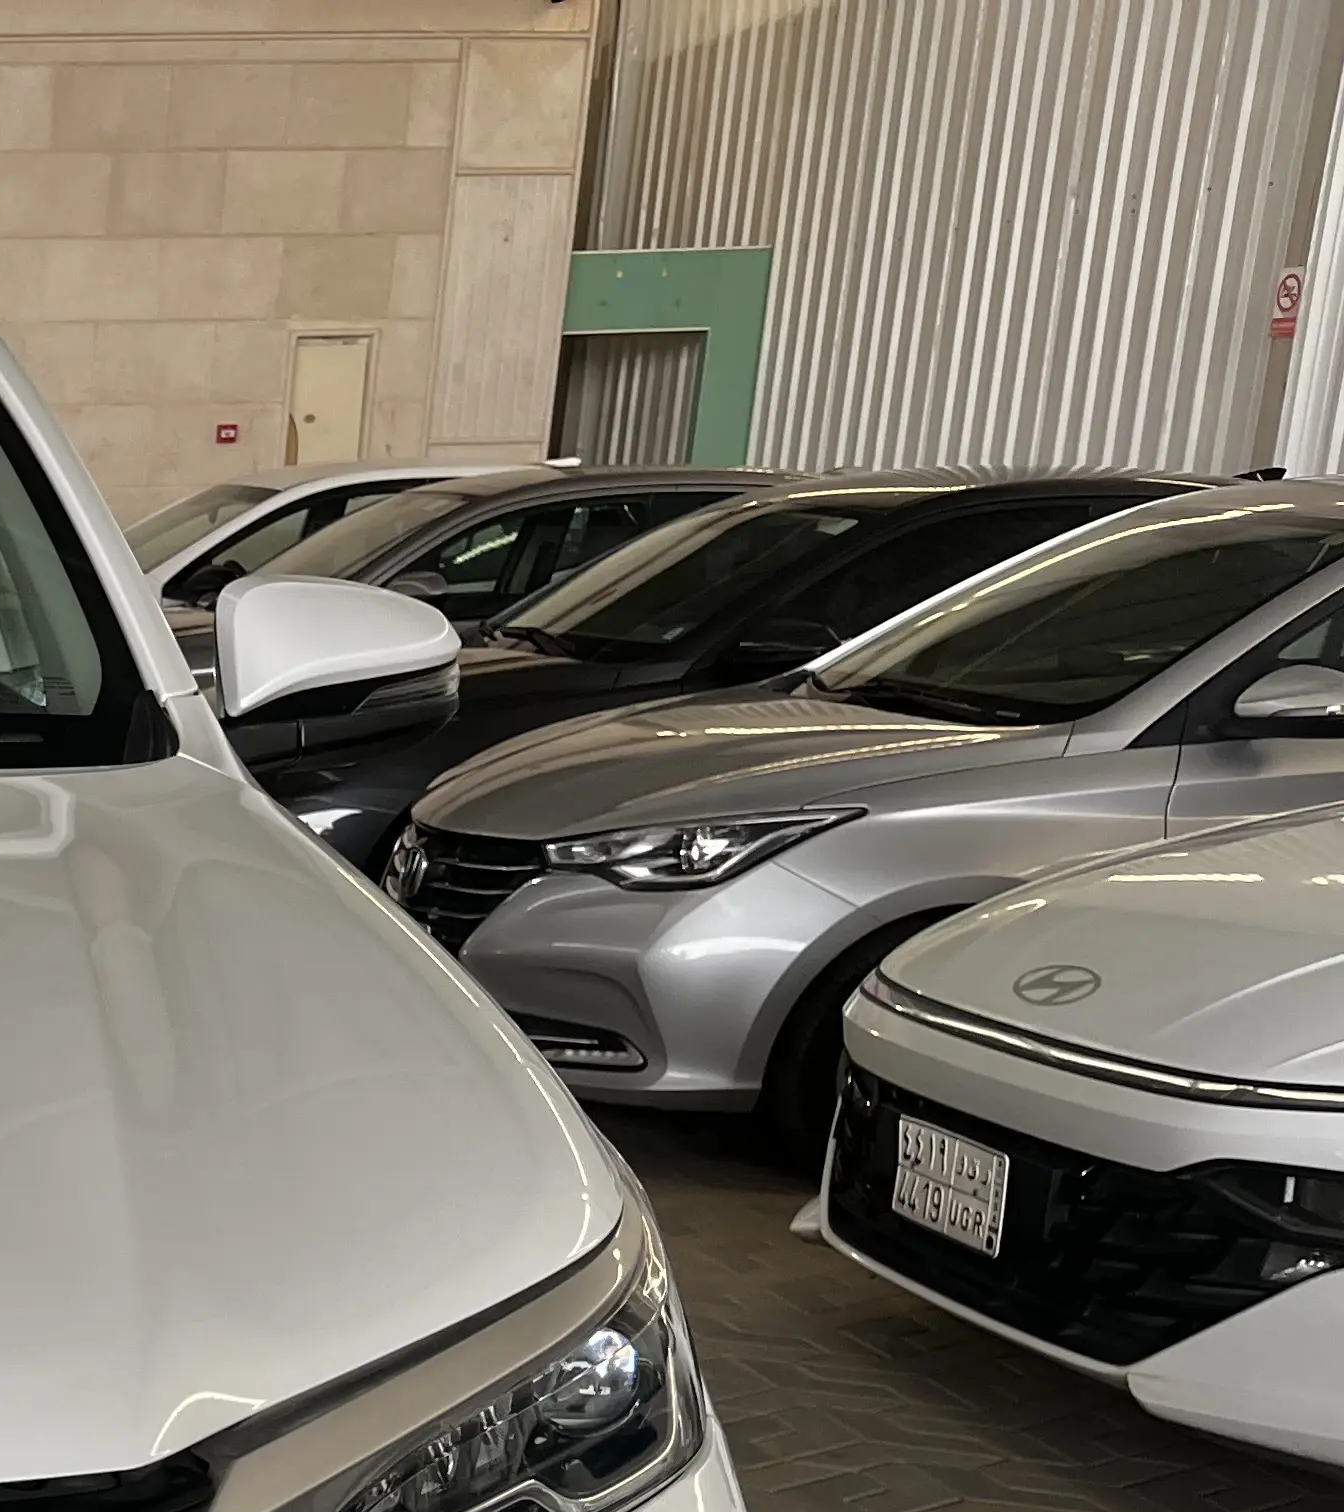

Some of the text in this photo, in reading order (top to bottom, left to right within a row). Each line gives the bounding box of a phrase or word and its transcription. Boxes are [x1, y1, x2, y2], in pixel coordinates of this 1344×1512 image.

[903, 1124, 949, 1177] ٤٤١٩
[897, 1171, 945, 1223] 4419
[948, 1198, 987, 1239] UGR
